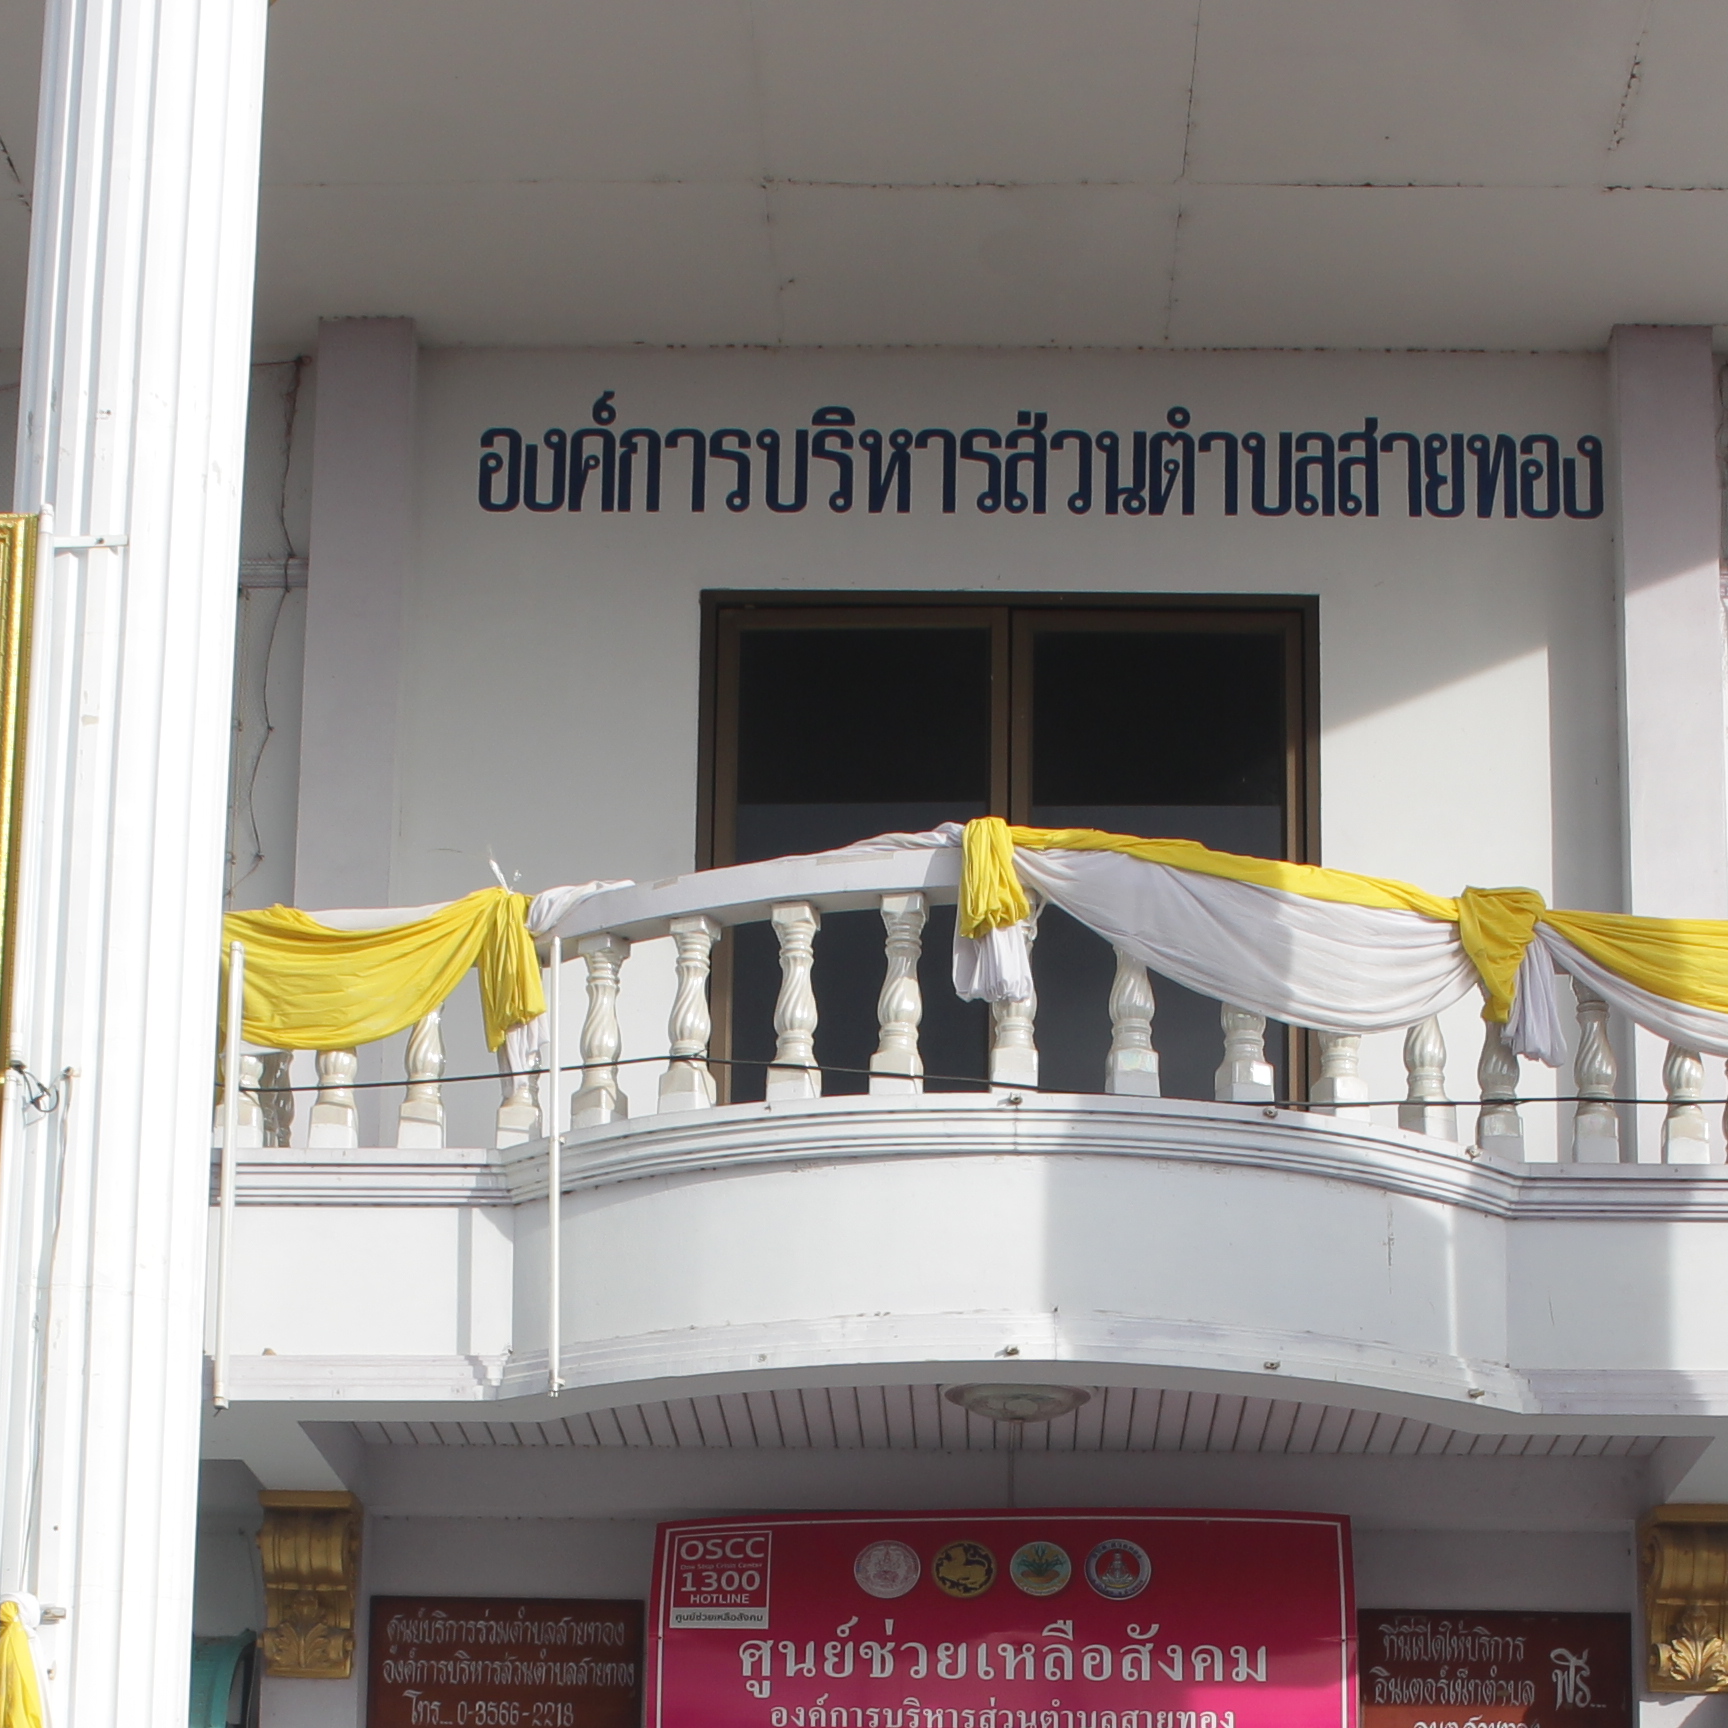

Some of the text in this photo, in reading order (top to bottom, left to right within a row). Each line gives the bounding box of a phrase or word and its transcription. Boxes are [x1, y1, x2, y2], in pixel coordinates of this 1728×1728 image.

[477, 390, 1604, 519] องค์การบริหารส่วนตำบลสายทอง
[680, 1537, 765, 1560] OSCC
[680, 1570, 761, 1591] 1300
[690, 1594, 750, 1604] HOTLINE
[738, 1616, 1267, 1698] ศูนย์ช่วยเหลือสังคม
